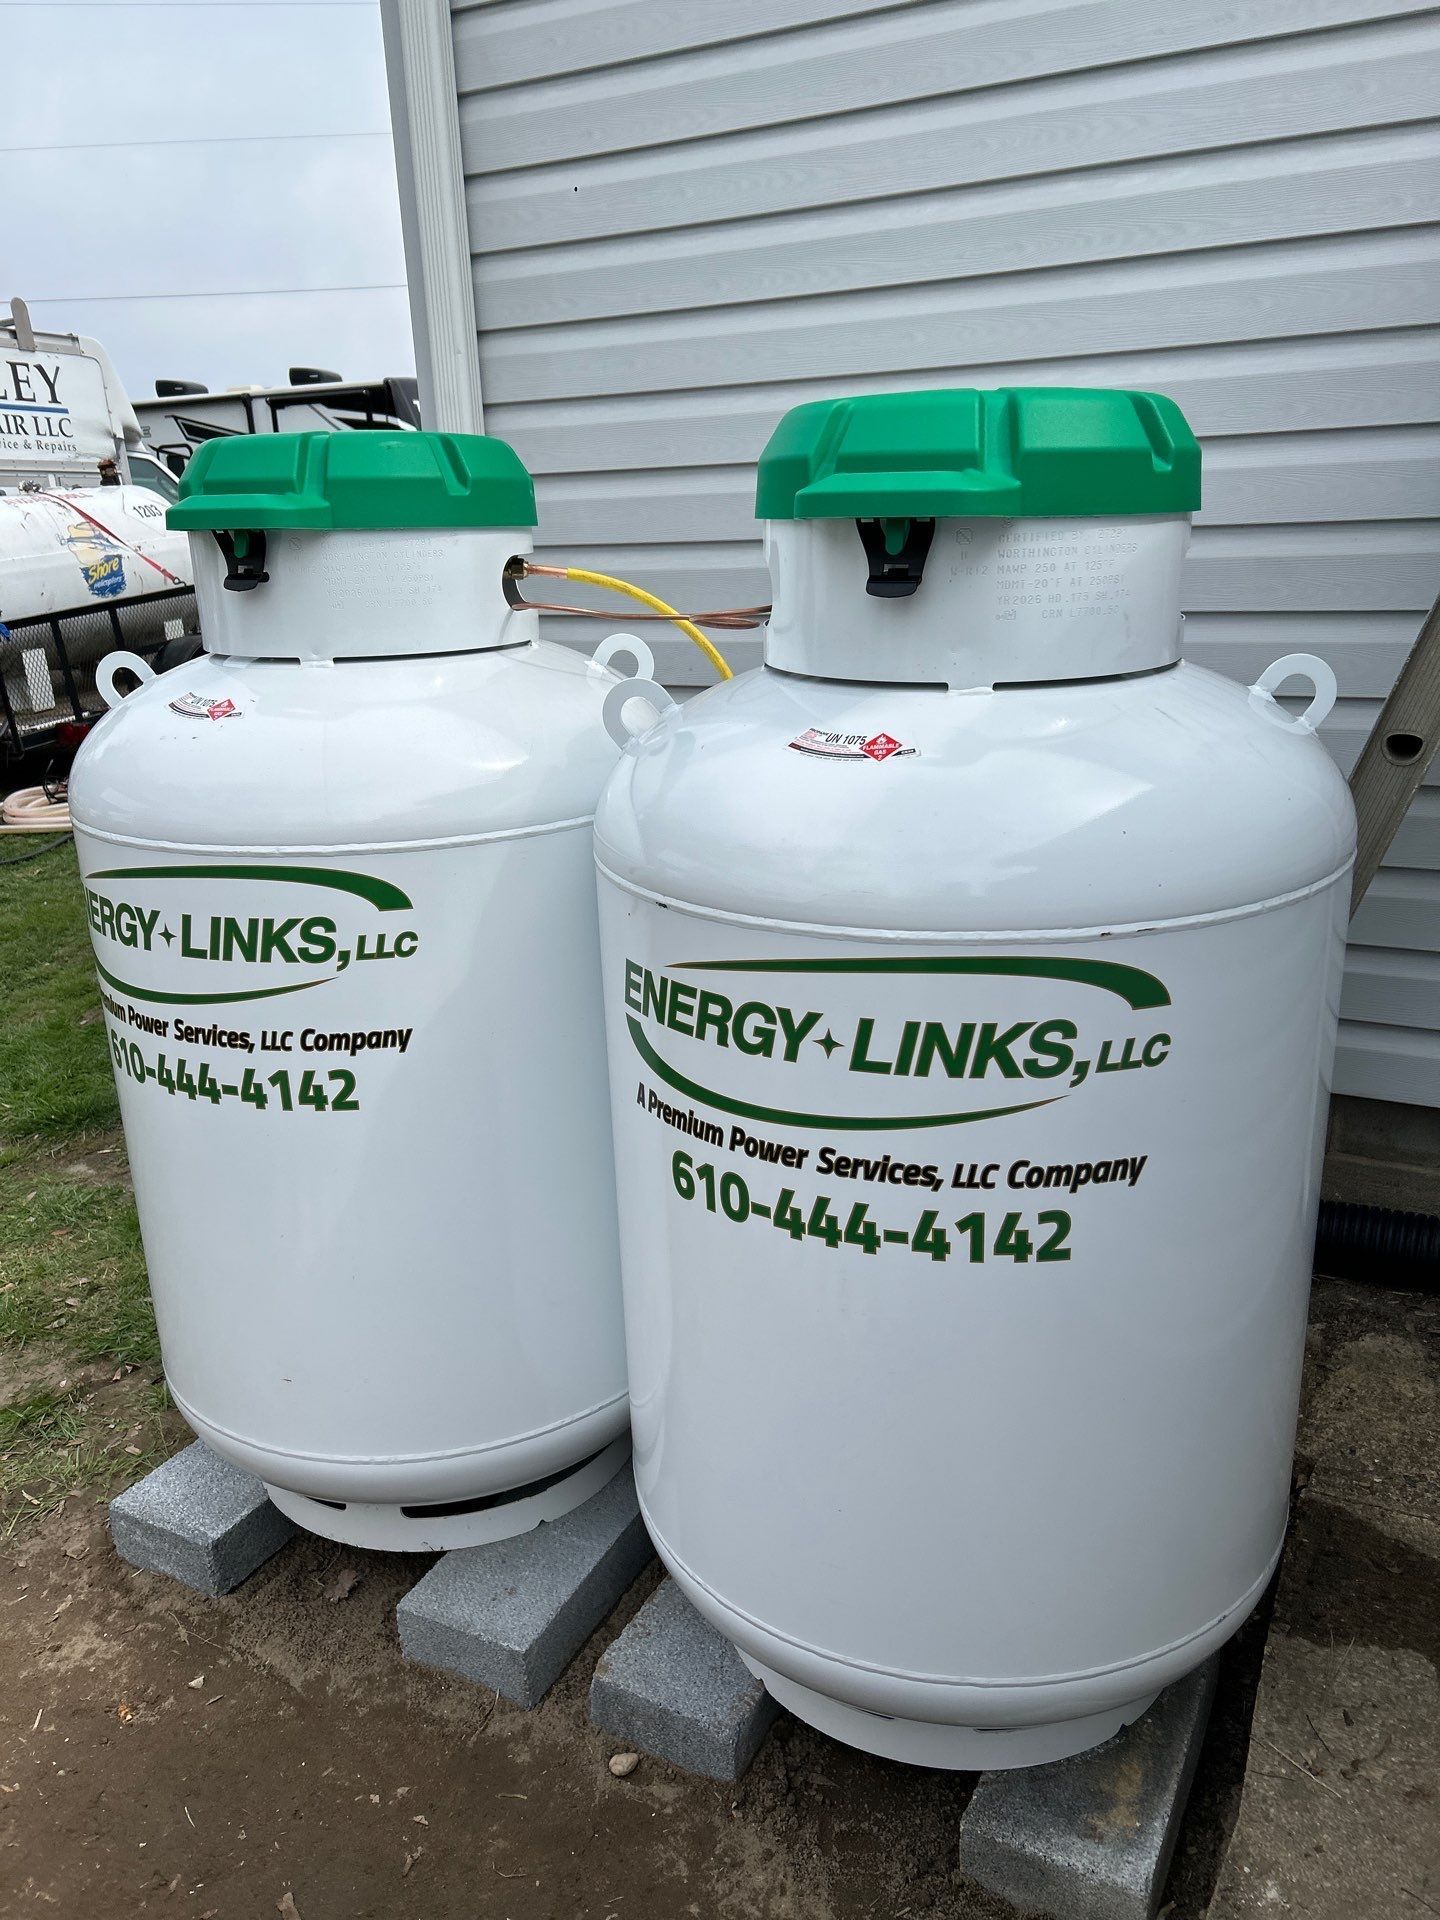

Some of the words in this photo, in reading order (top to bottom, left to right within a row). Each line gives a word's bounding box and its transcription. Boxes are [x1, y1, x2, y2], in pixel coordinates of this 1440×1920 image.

[0, 360, 63, 405] EY
[32, 415, 74, 438] LLC
[0, 438, 19, 449] ice
[23, 439, 32, 450] &
[36, 440, 78, 454] Repairs
[132, 503, 163, 519] 1203
[997, 546, 1079, 559] WORTHINGTON
[88, 557, 119, 586] Shore
[996, 563, 1028, 575] MAWP
[1034, 562, 1057, 574] 250
[1063, 562, 1078, 572] AT
[1070, 576, 1083, 586] AT
[825, 732, 843, 744] UN
[843, 735, 868, 746] 1075
[862, 743, 900, 751] FLAMMABLE
[181, 913, 351, 972] LINKS,
[355, 930, 419, 961] LLC
[127, 1004, 169, 1037] Power
[173, 1018, 256, 1054] Services,
[260, 1030, 294, 1052] LLC
[300, 1026, 413, 1057] Company
[624, 957, 823, 1064] ENERGY
[848, 1017, 1089, 1088] LINKS,
[1095, 1032, 1172, 1074] LLC
[110, 1028, 360, 1112] 610-444-4142
[636, 1082, 647, 1107] A
[648, 1090, 725, 1149] Premium
[729, 1126, 809, 1169] Power
[816, 1147, 945, 1192] Services,
[951, 1163, 1000, 1190] LLC
[1006, 1154, 1149, 1194] Company
[670, 1149, 1073, 1264] 610-444-4142
